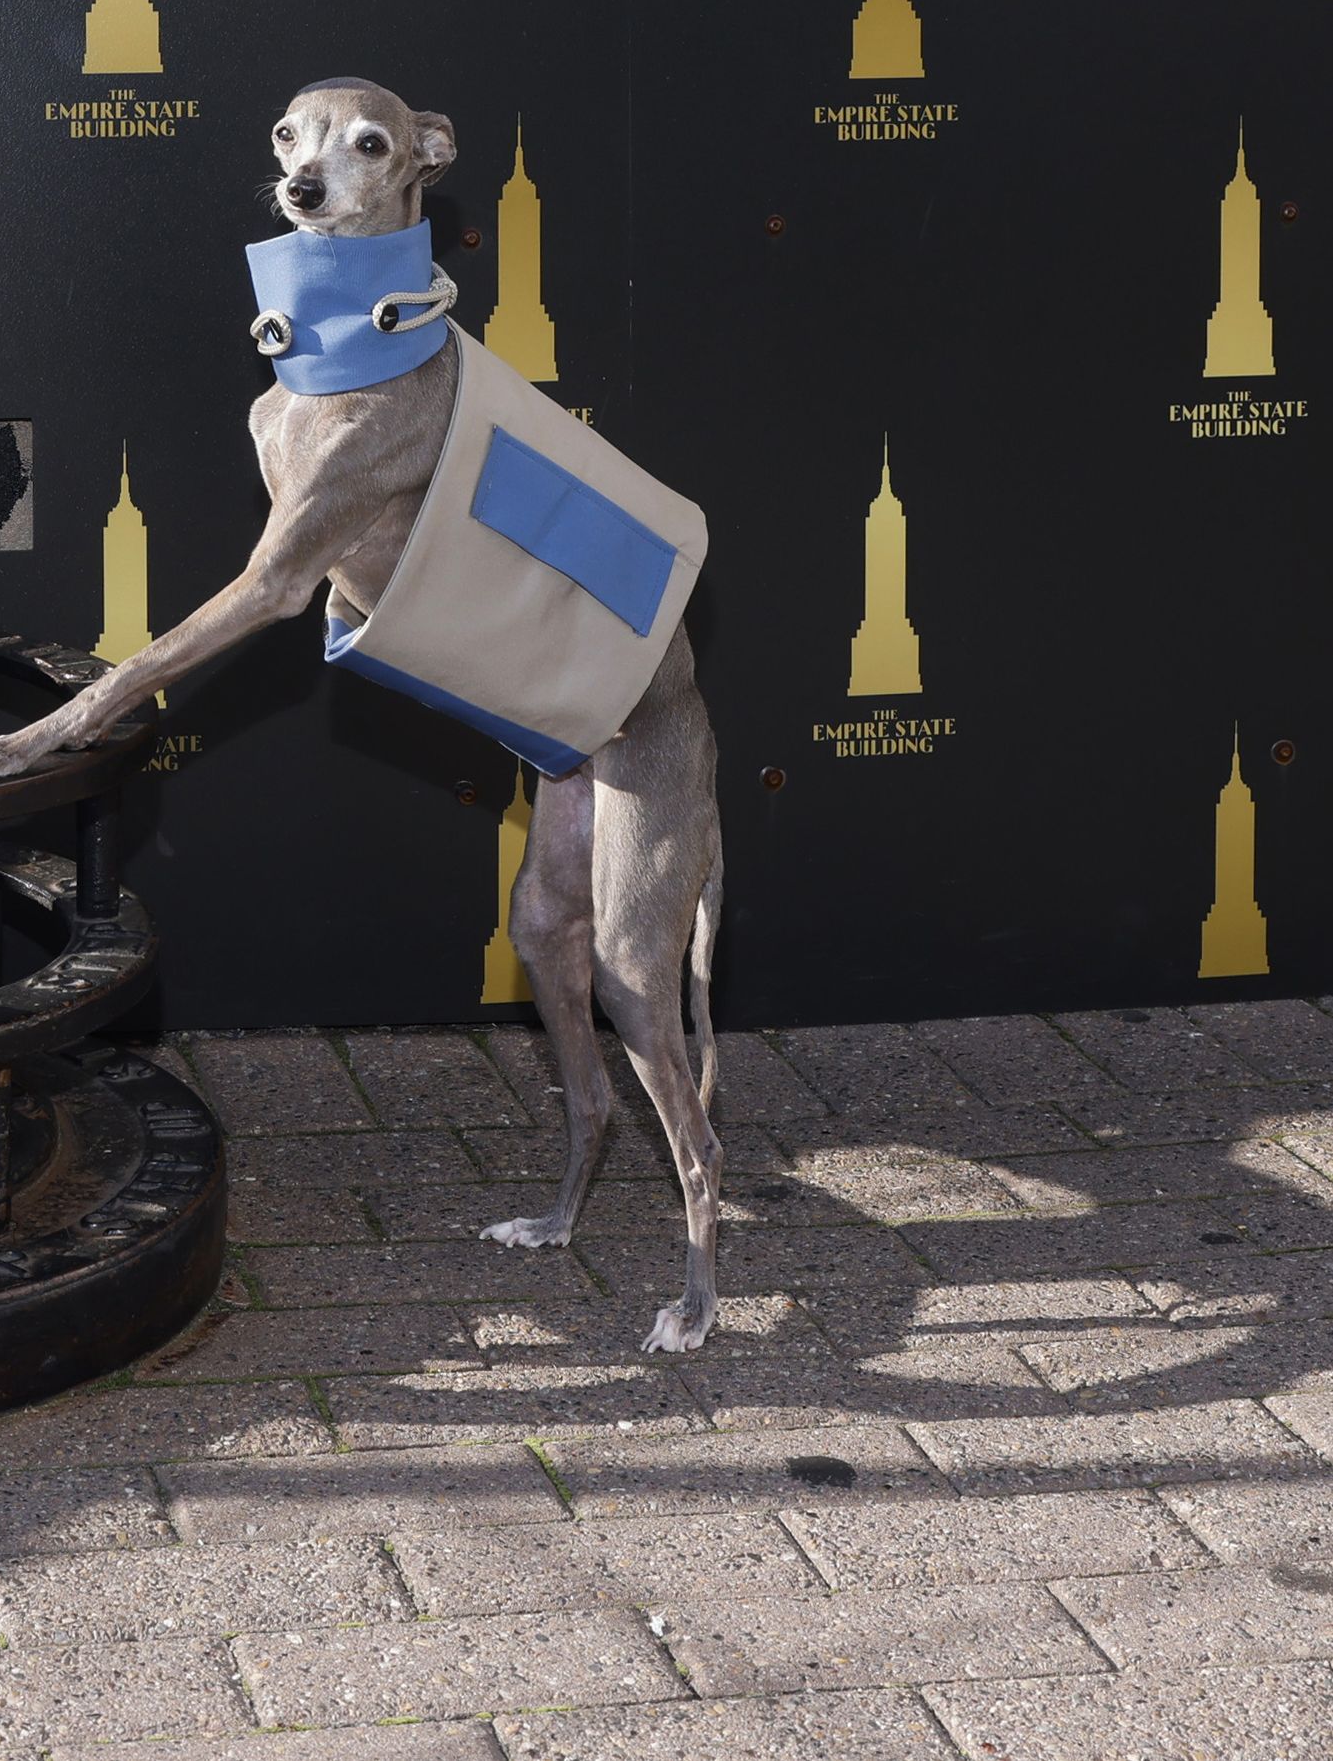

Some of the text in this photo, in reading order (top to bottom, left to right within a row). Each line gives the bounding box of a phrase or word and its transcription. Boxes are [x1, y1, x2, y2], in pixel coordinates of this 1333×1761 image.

[109, 89, 137, 100] THE
[873, 93, 900, 104] THE
[45, 100, 200, 120] EMPIRE STATE
[813, 104, 959, 124] EMPIRE STATE
[70, 119, 175, 138] BUILDING
[837, 121, 936, 141] BUILDING
[1227, 391, 1252, 402] THE
[1169, 400, 1308, 421] EMPIRE STATE
[1191, 418, 1286, 439] BUILDING
[872, 709, 898, 720] THE
[812, 718, 956, 741] EMPIRE STATE
[156, 735, 204, 753] ATE
[835, 737, 934, 758] BUILDING
